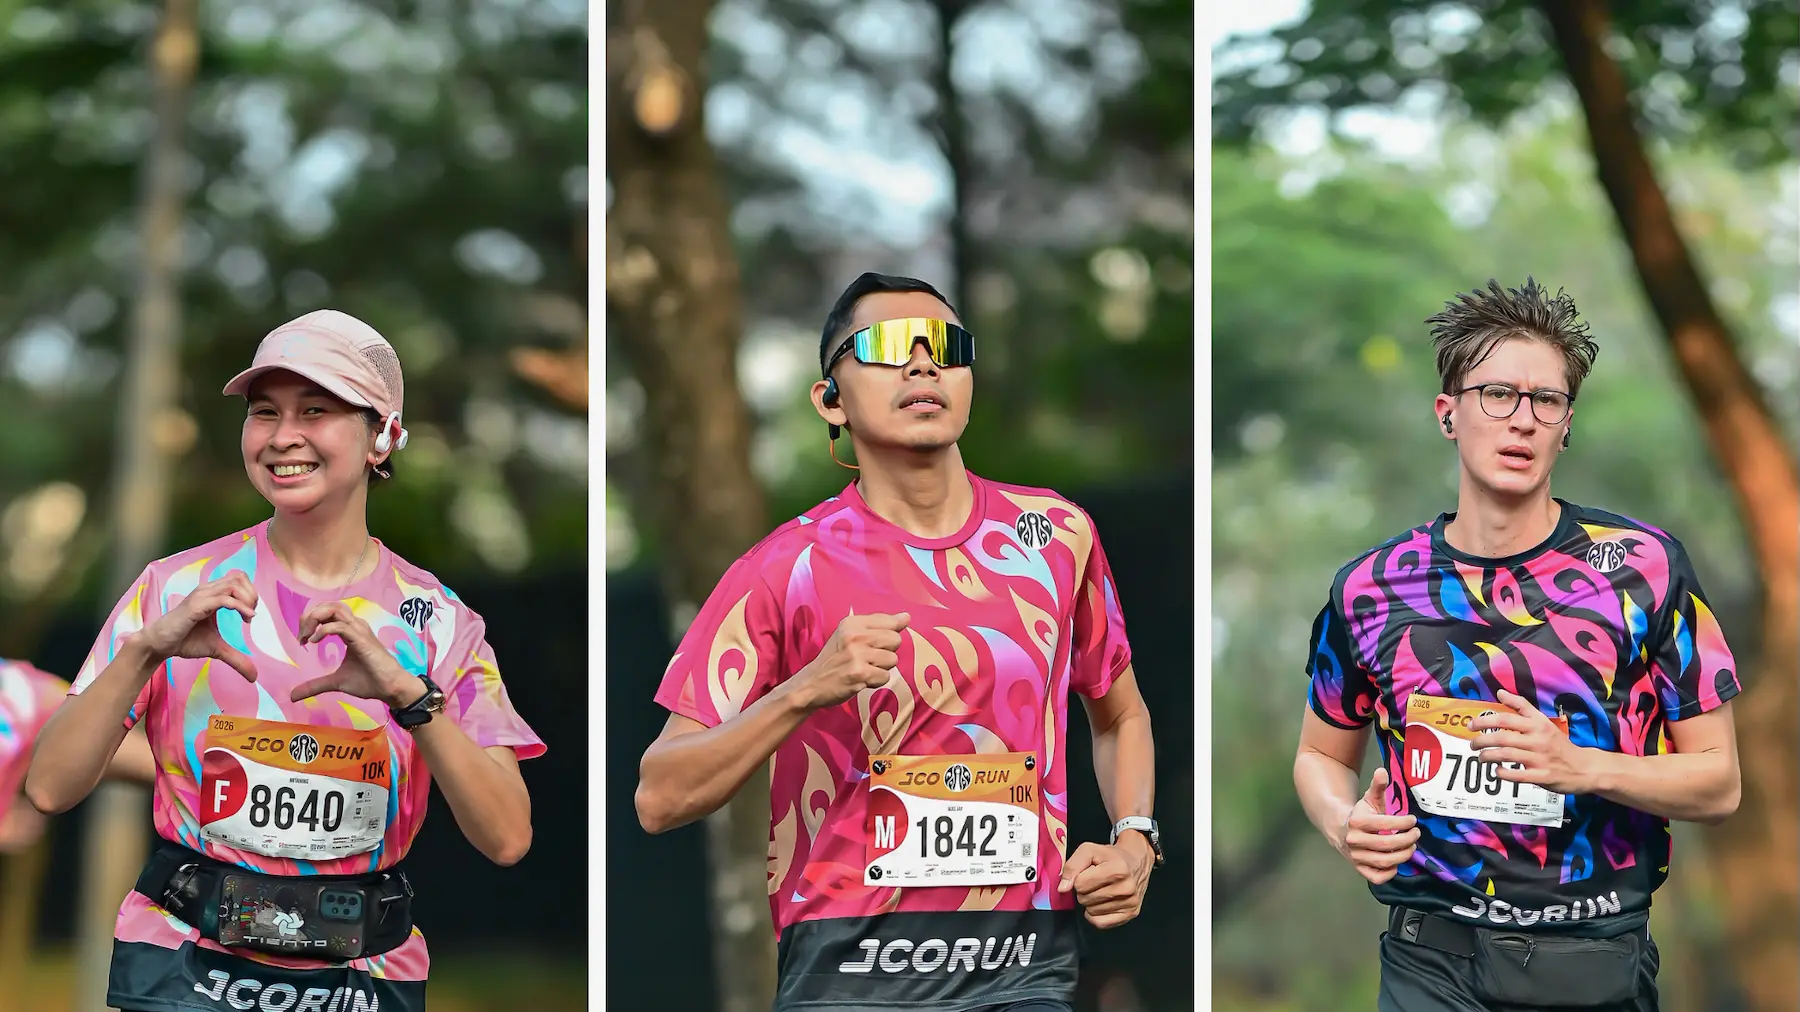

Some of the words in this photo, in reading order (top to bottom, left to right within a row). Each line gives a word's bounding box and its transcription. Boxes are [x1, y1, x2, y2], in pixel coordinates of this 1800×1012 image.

[1412, 698, 1431, 710] 2026
[213, 719, 234, 731] 2026
[240, 736, 285, 753] JCO
[322, 743, 364, 760] RUN
[361, 760, 385, 780] 10K
[898, 772, 940, 786] JCO
[974, 770, 1010, 784] RUN
[1411, 748, 1431, 781] M
[213, 779, 231, 813] F
[250, 784, 345, 832] 8640
[1009, 785, 1033, 803] 10K
[874, 815, 896, 849] M
[916, 814, 998, 858] 1842
[838, 932, 1037, 974] JCORUN
